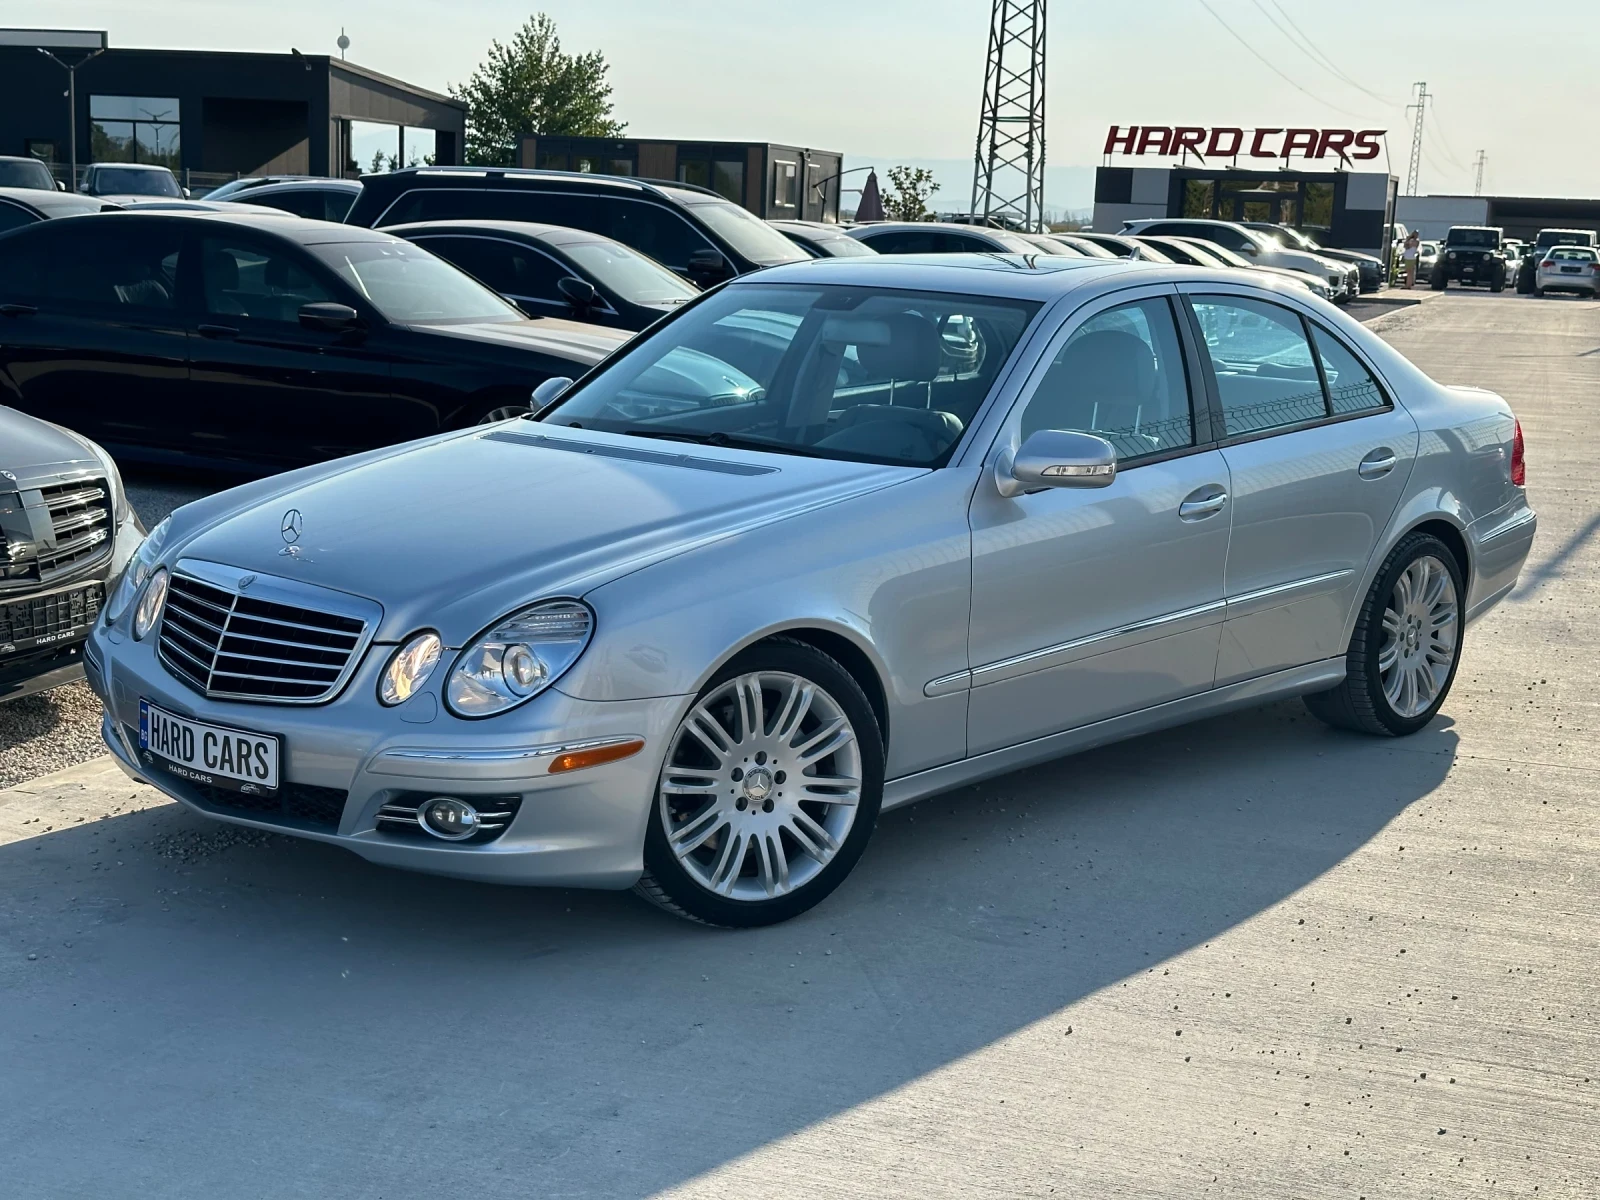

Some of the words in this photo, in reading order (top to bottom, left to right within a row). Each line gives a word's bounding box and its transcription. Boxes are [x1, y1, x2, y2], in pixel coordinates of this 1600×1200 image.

[1103, 125, 1244, 166] HARD
[1249, 127, 1388, 169] CARS
[36, 636, 56, 645] HARD
[57, 630, 75, 640] CARS
[151, 711, 195, 763] HARD
[203, 731, 269, 780] CARS
[168, 763, 188, 776] HARD
[189, 772, 213, 784] CARS
